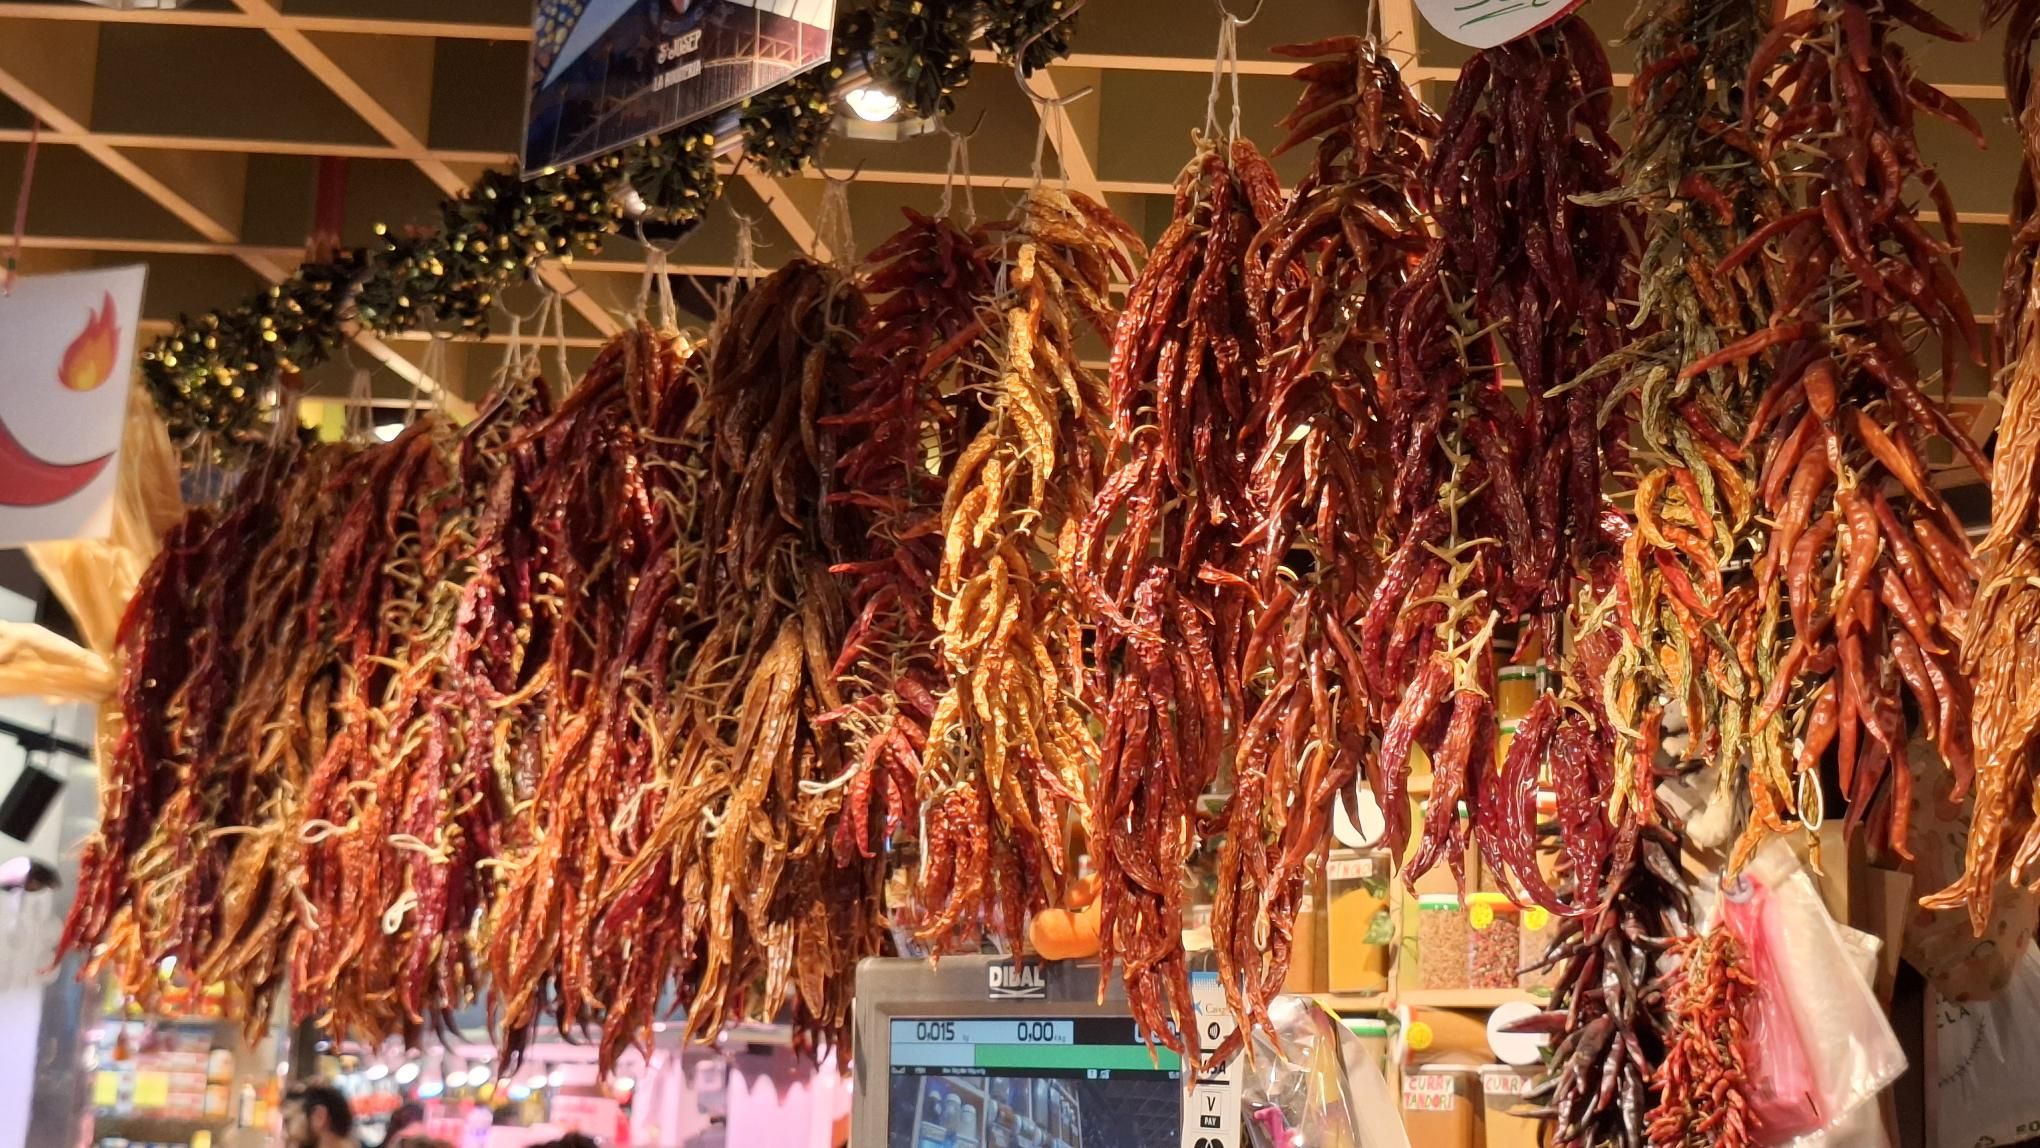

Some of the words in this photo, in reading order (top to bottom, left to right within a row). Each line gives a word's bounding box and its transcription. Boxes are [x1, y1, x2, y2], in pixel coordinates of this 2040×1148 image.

[916, 1022, 955, 1042] 0,015
[1017, 1022, 1054, 1043] 0,00
[1206, 1096, 1216, 1111] V
[1203, 1116, 1217, 1127] PAY
